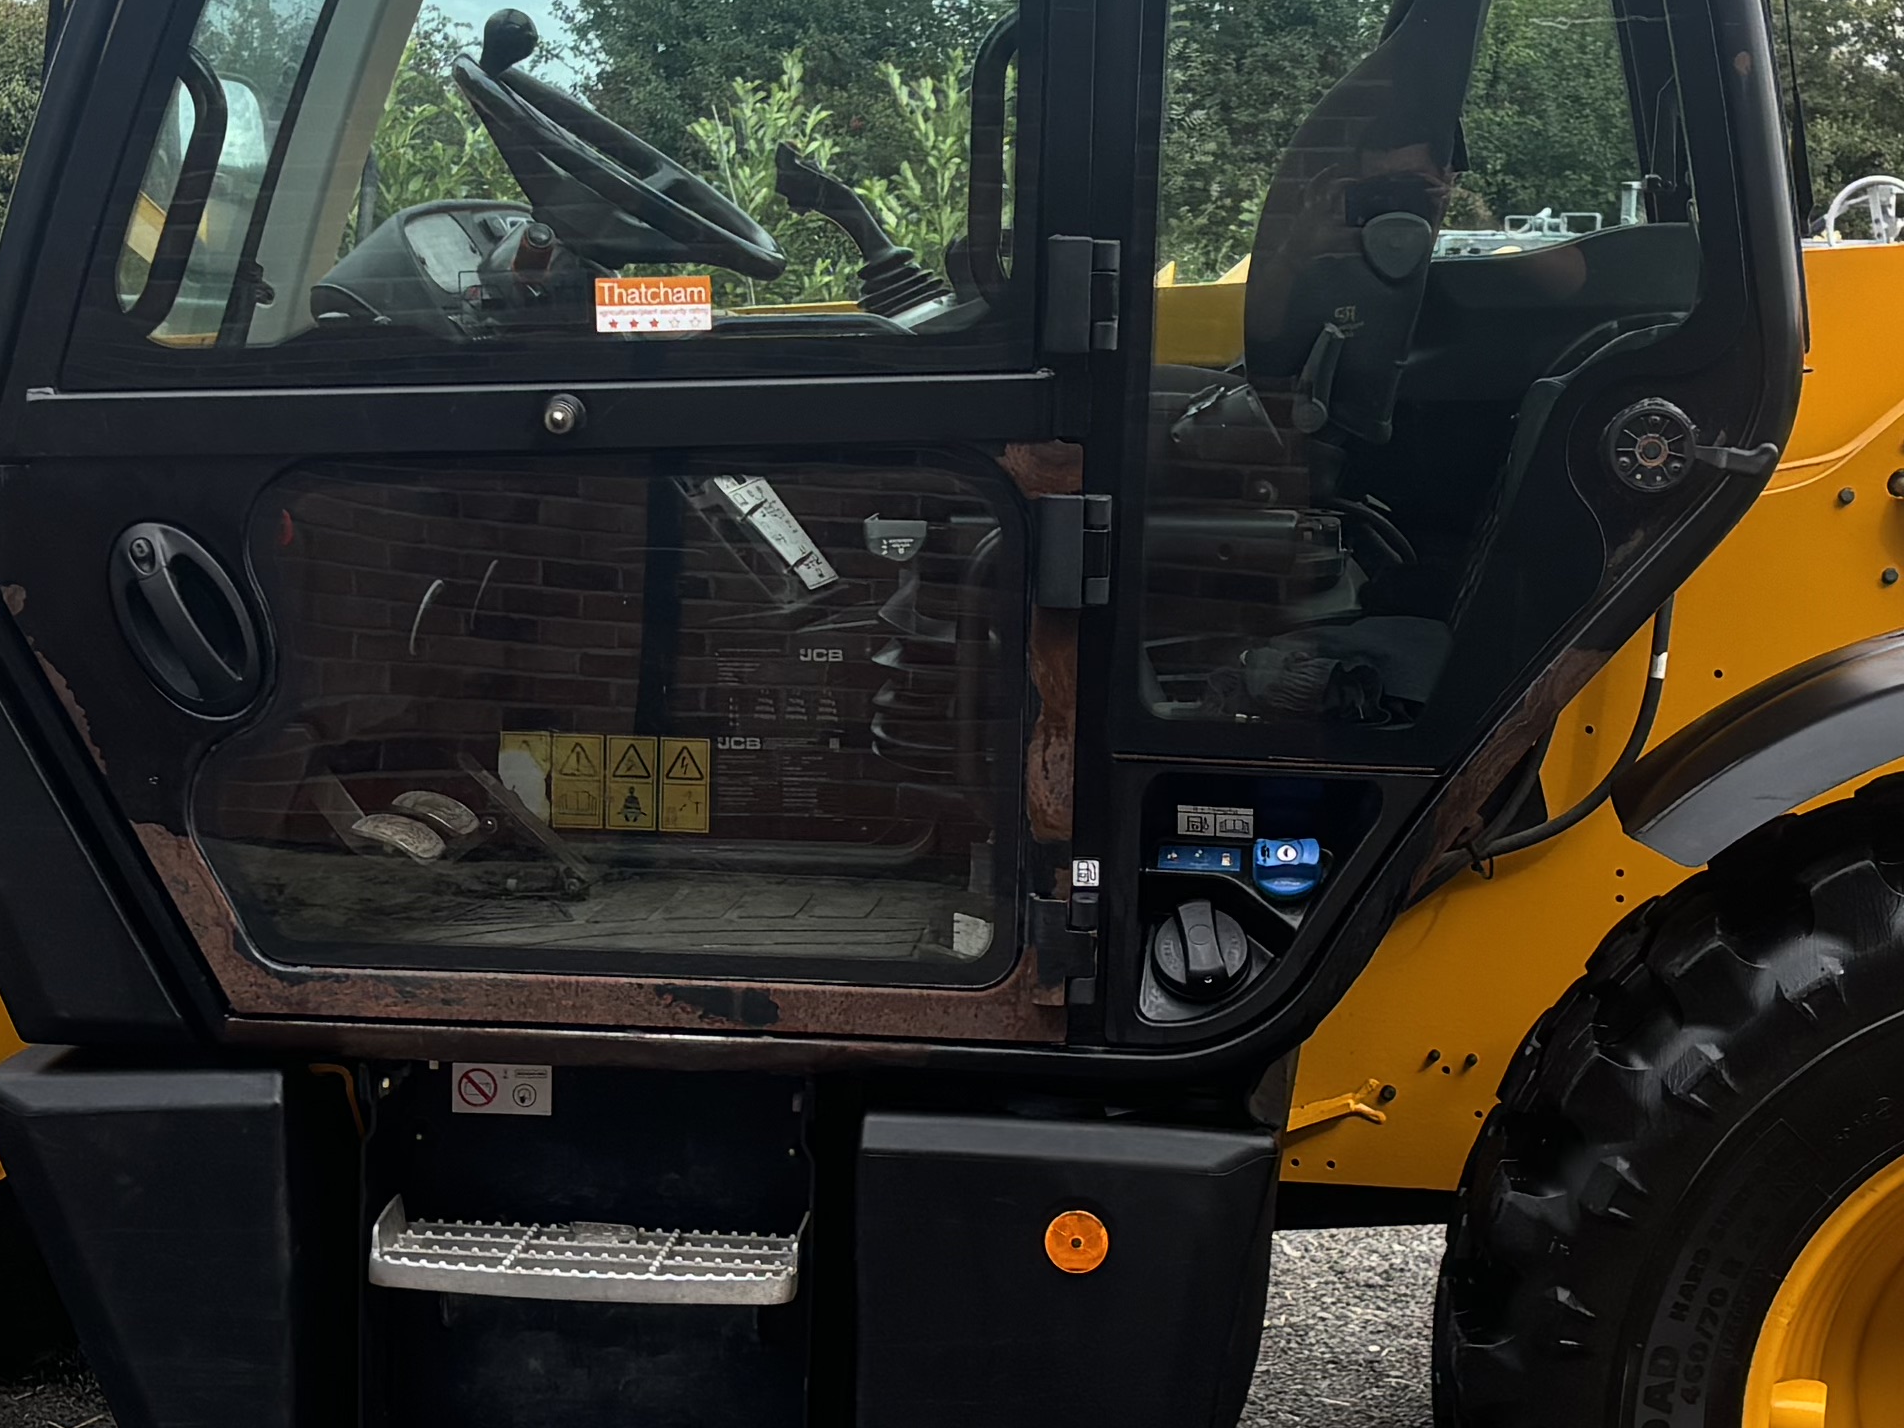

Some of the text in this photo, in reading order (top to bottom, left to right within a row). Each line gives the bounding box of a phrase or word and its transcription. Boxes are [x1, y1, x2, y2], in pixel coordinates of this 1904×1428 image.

[598, 281, 706, 304] Thatcham
[799, 648, 844, 662] JCB
[717, 737, 762, 750] JCB
